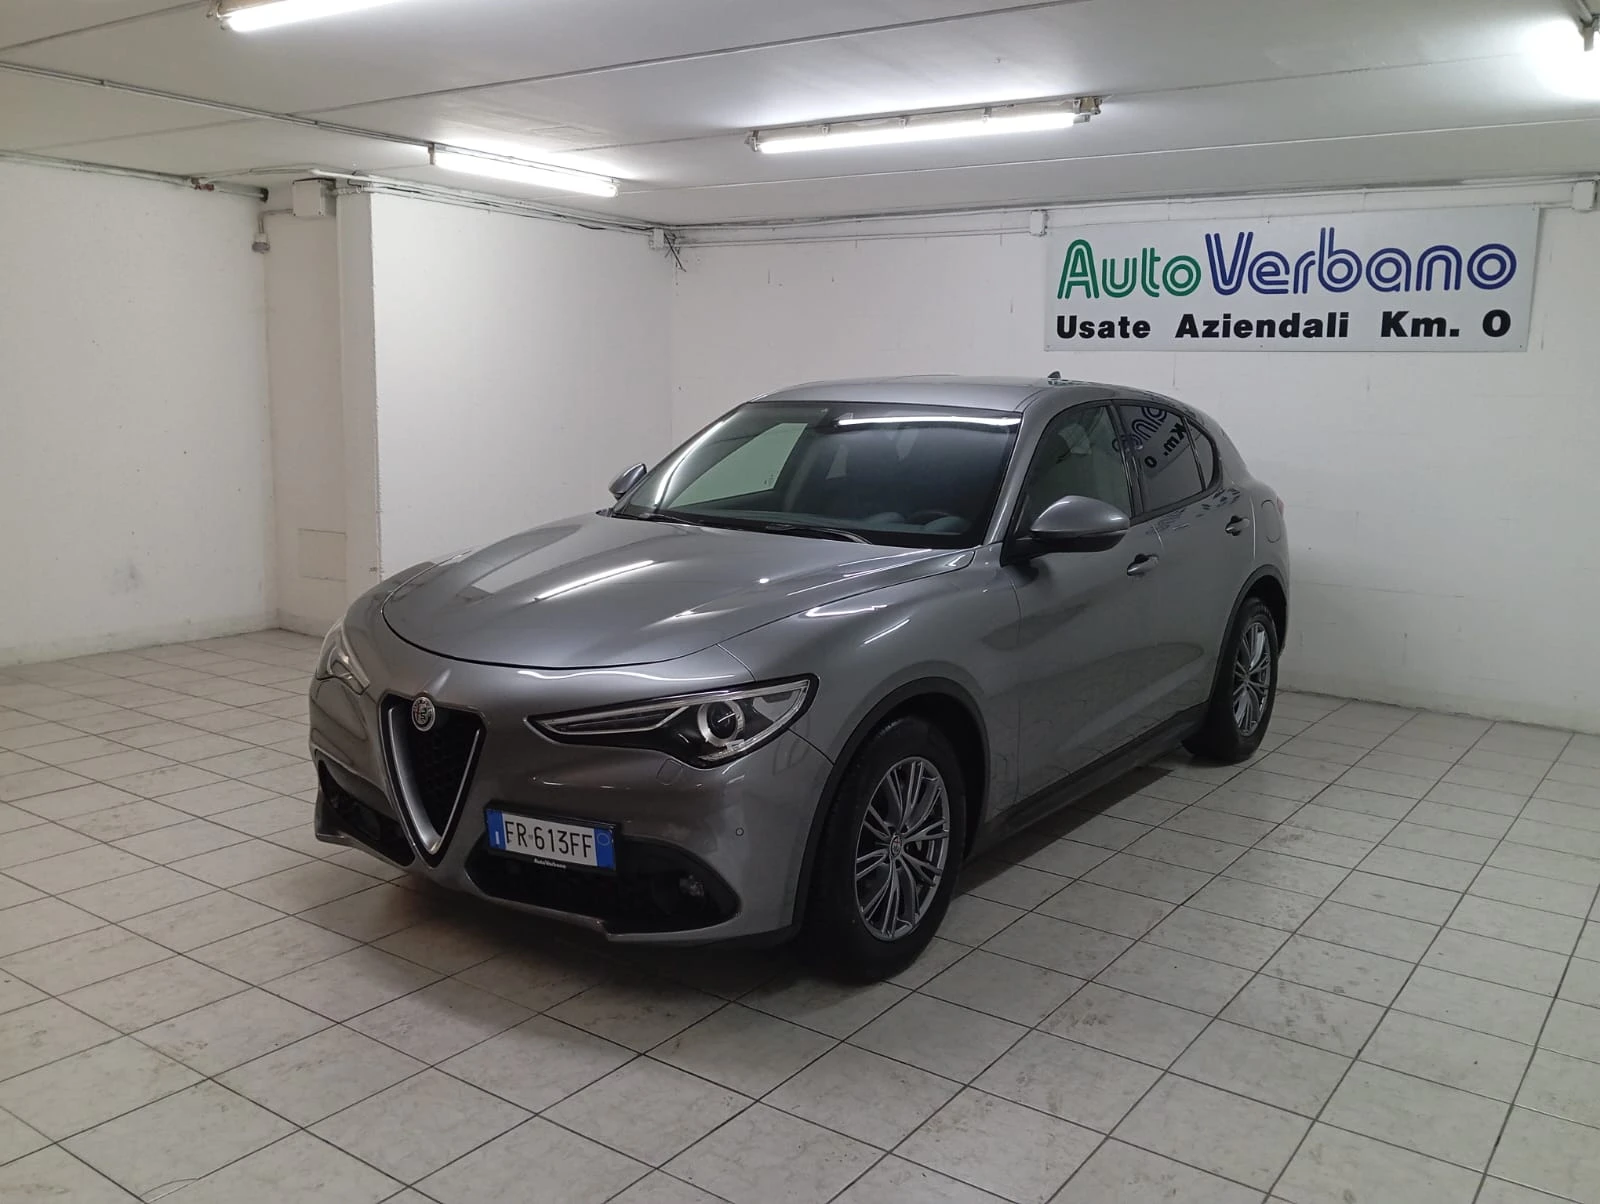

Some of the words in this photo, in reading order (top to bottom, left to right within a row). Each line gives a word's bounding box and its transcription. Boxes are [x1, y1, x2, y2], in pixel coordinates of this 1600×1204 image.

[1056, 313, 1151, 340] Usate
[1175, 311, 1350, 340] Aziendali
[1380, 310, 1460, 339] Km.
[505, 820, 528, 848] FR
[533, 826, 593, 858] 613FF
